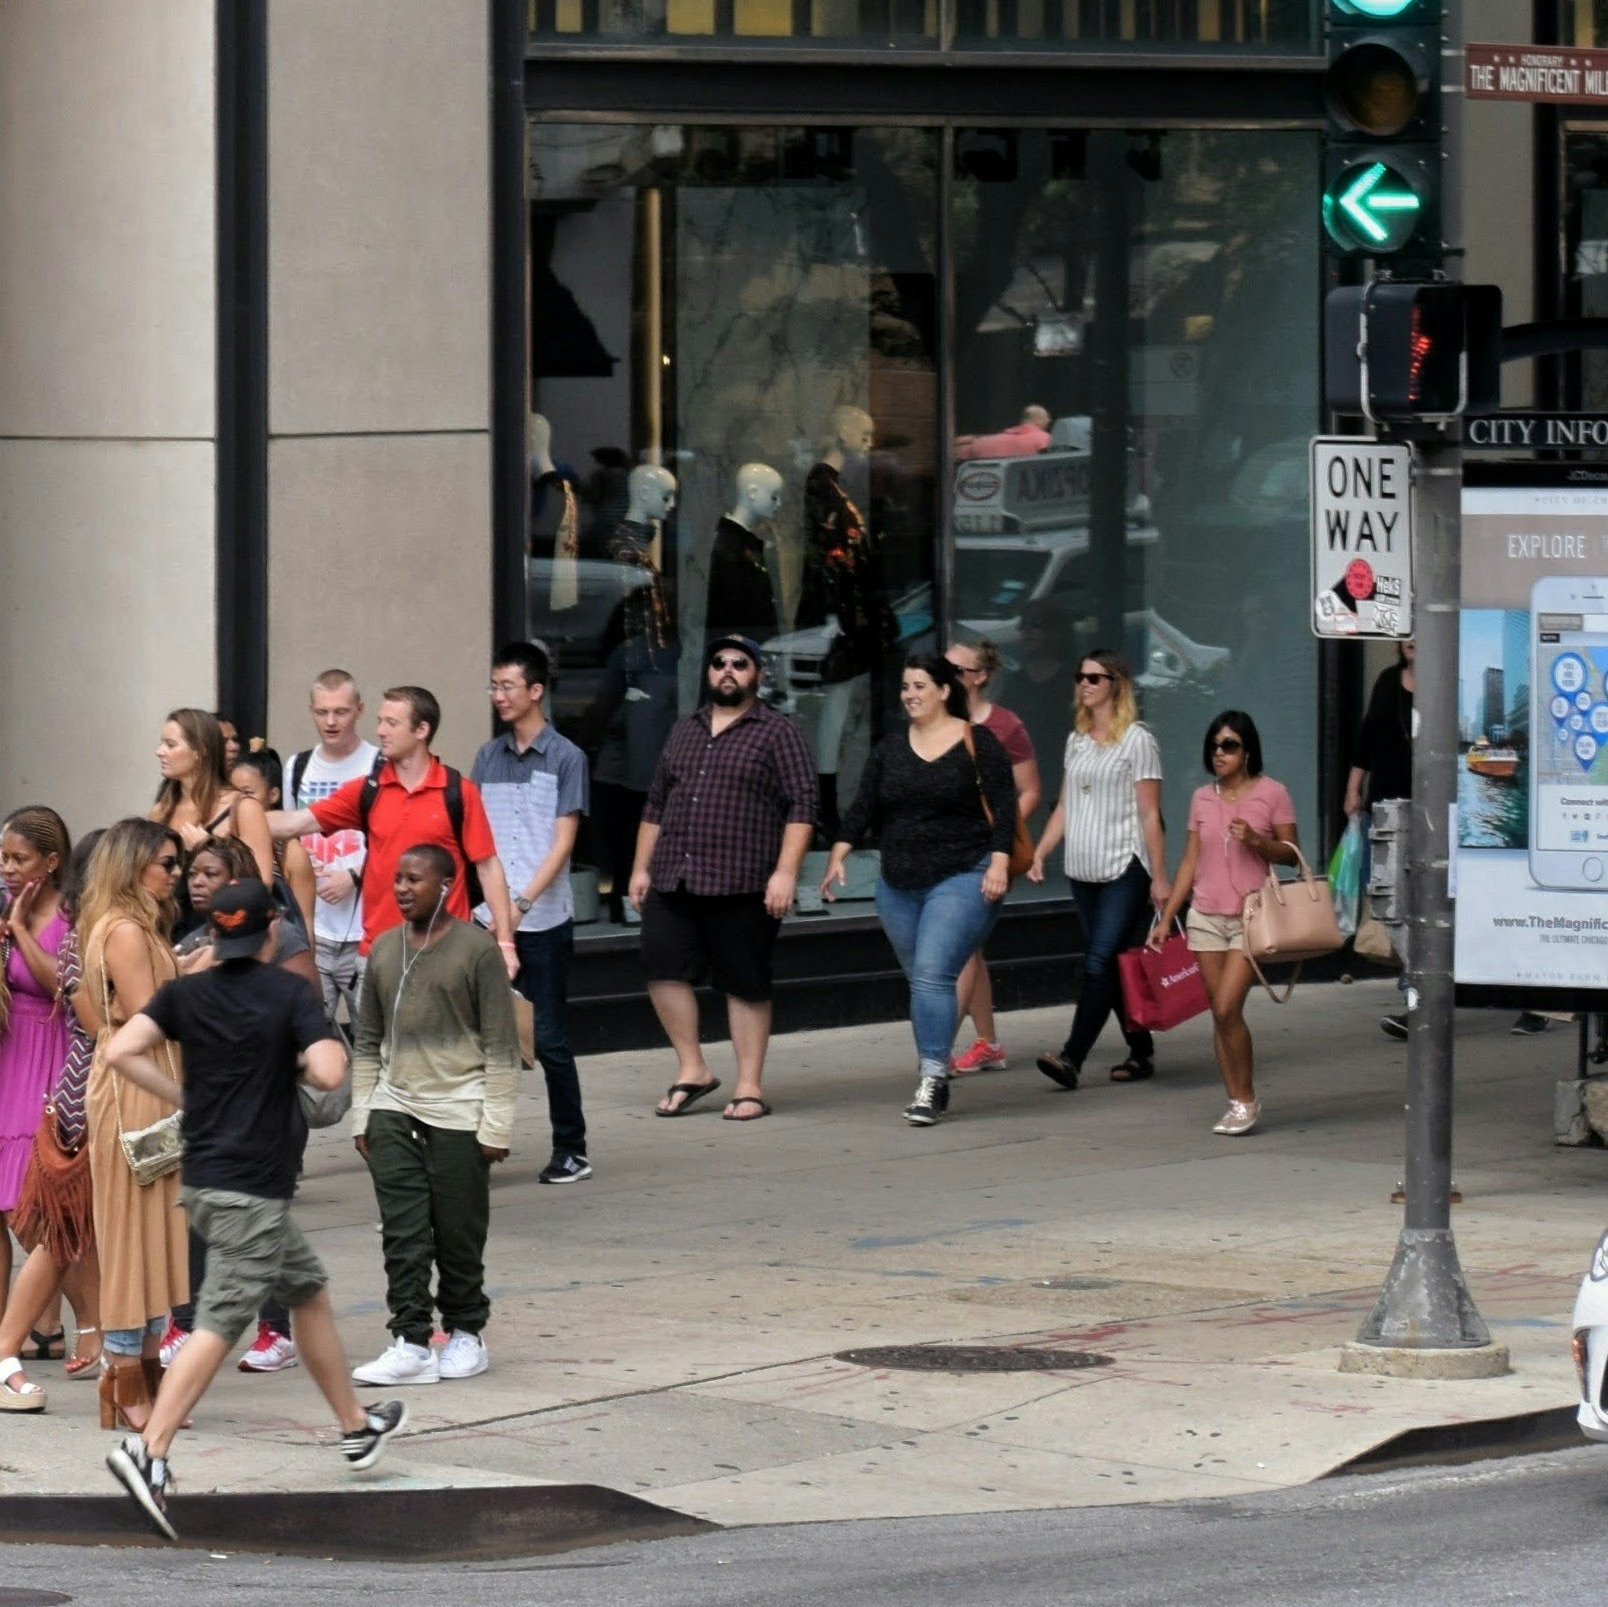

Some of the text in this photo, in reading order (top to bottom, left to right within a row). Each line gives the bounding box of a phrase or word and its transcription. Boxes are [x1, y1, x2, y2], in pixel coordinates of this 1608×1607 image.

[1470, 64, 1608, 95] THE MAGNIFICENT MIL
[1469, 419, 1535, 444] CITY
[1328, 455, 1396, 499] ONE
[1325, 509, 1399, 552] WAY
[1507, 535, 1587, 559] EXPLORE
